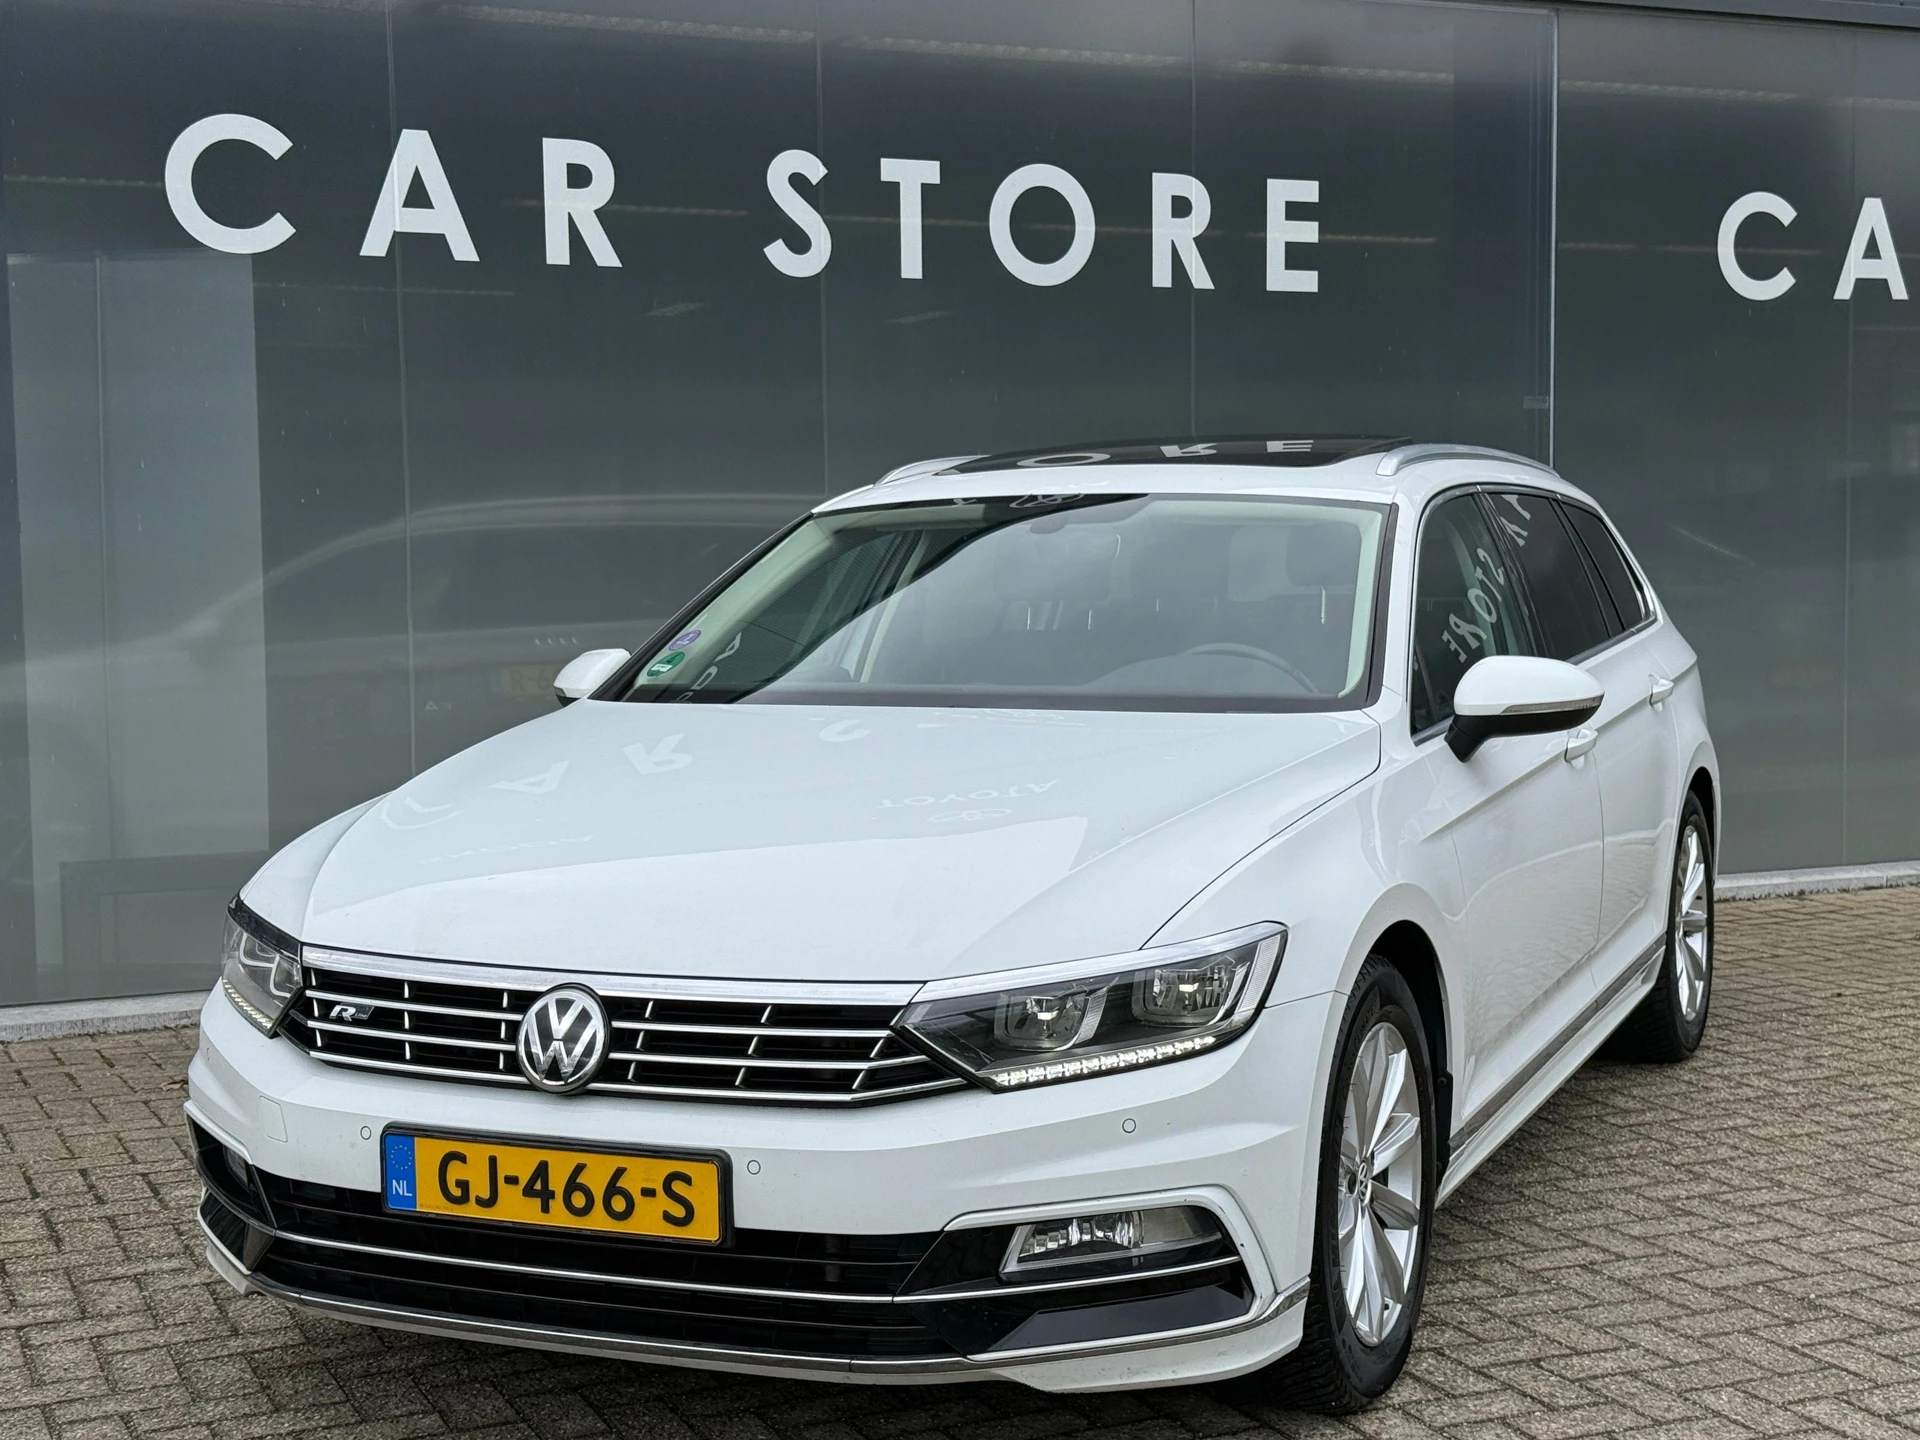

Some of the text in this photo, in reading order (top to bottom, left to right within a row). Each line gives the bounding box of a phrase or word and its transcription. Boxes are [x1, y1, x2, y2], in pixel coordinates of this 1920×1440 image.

[164, 113, 1320, 293] CAR STORE
[1717, 191, 1909, 301] CA
[392, 1179, 413, 1197] NL
[438, 1150, 695, 1228] GJ-466-S
